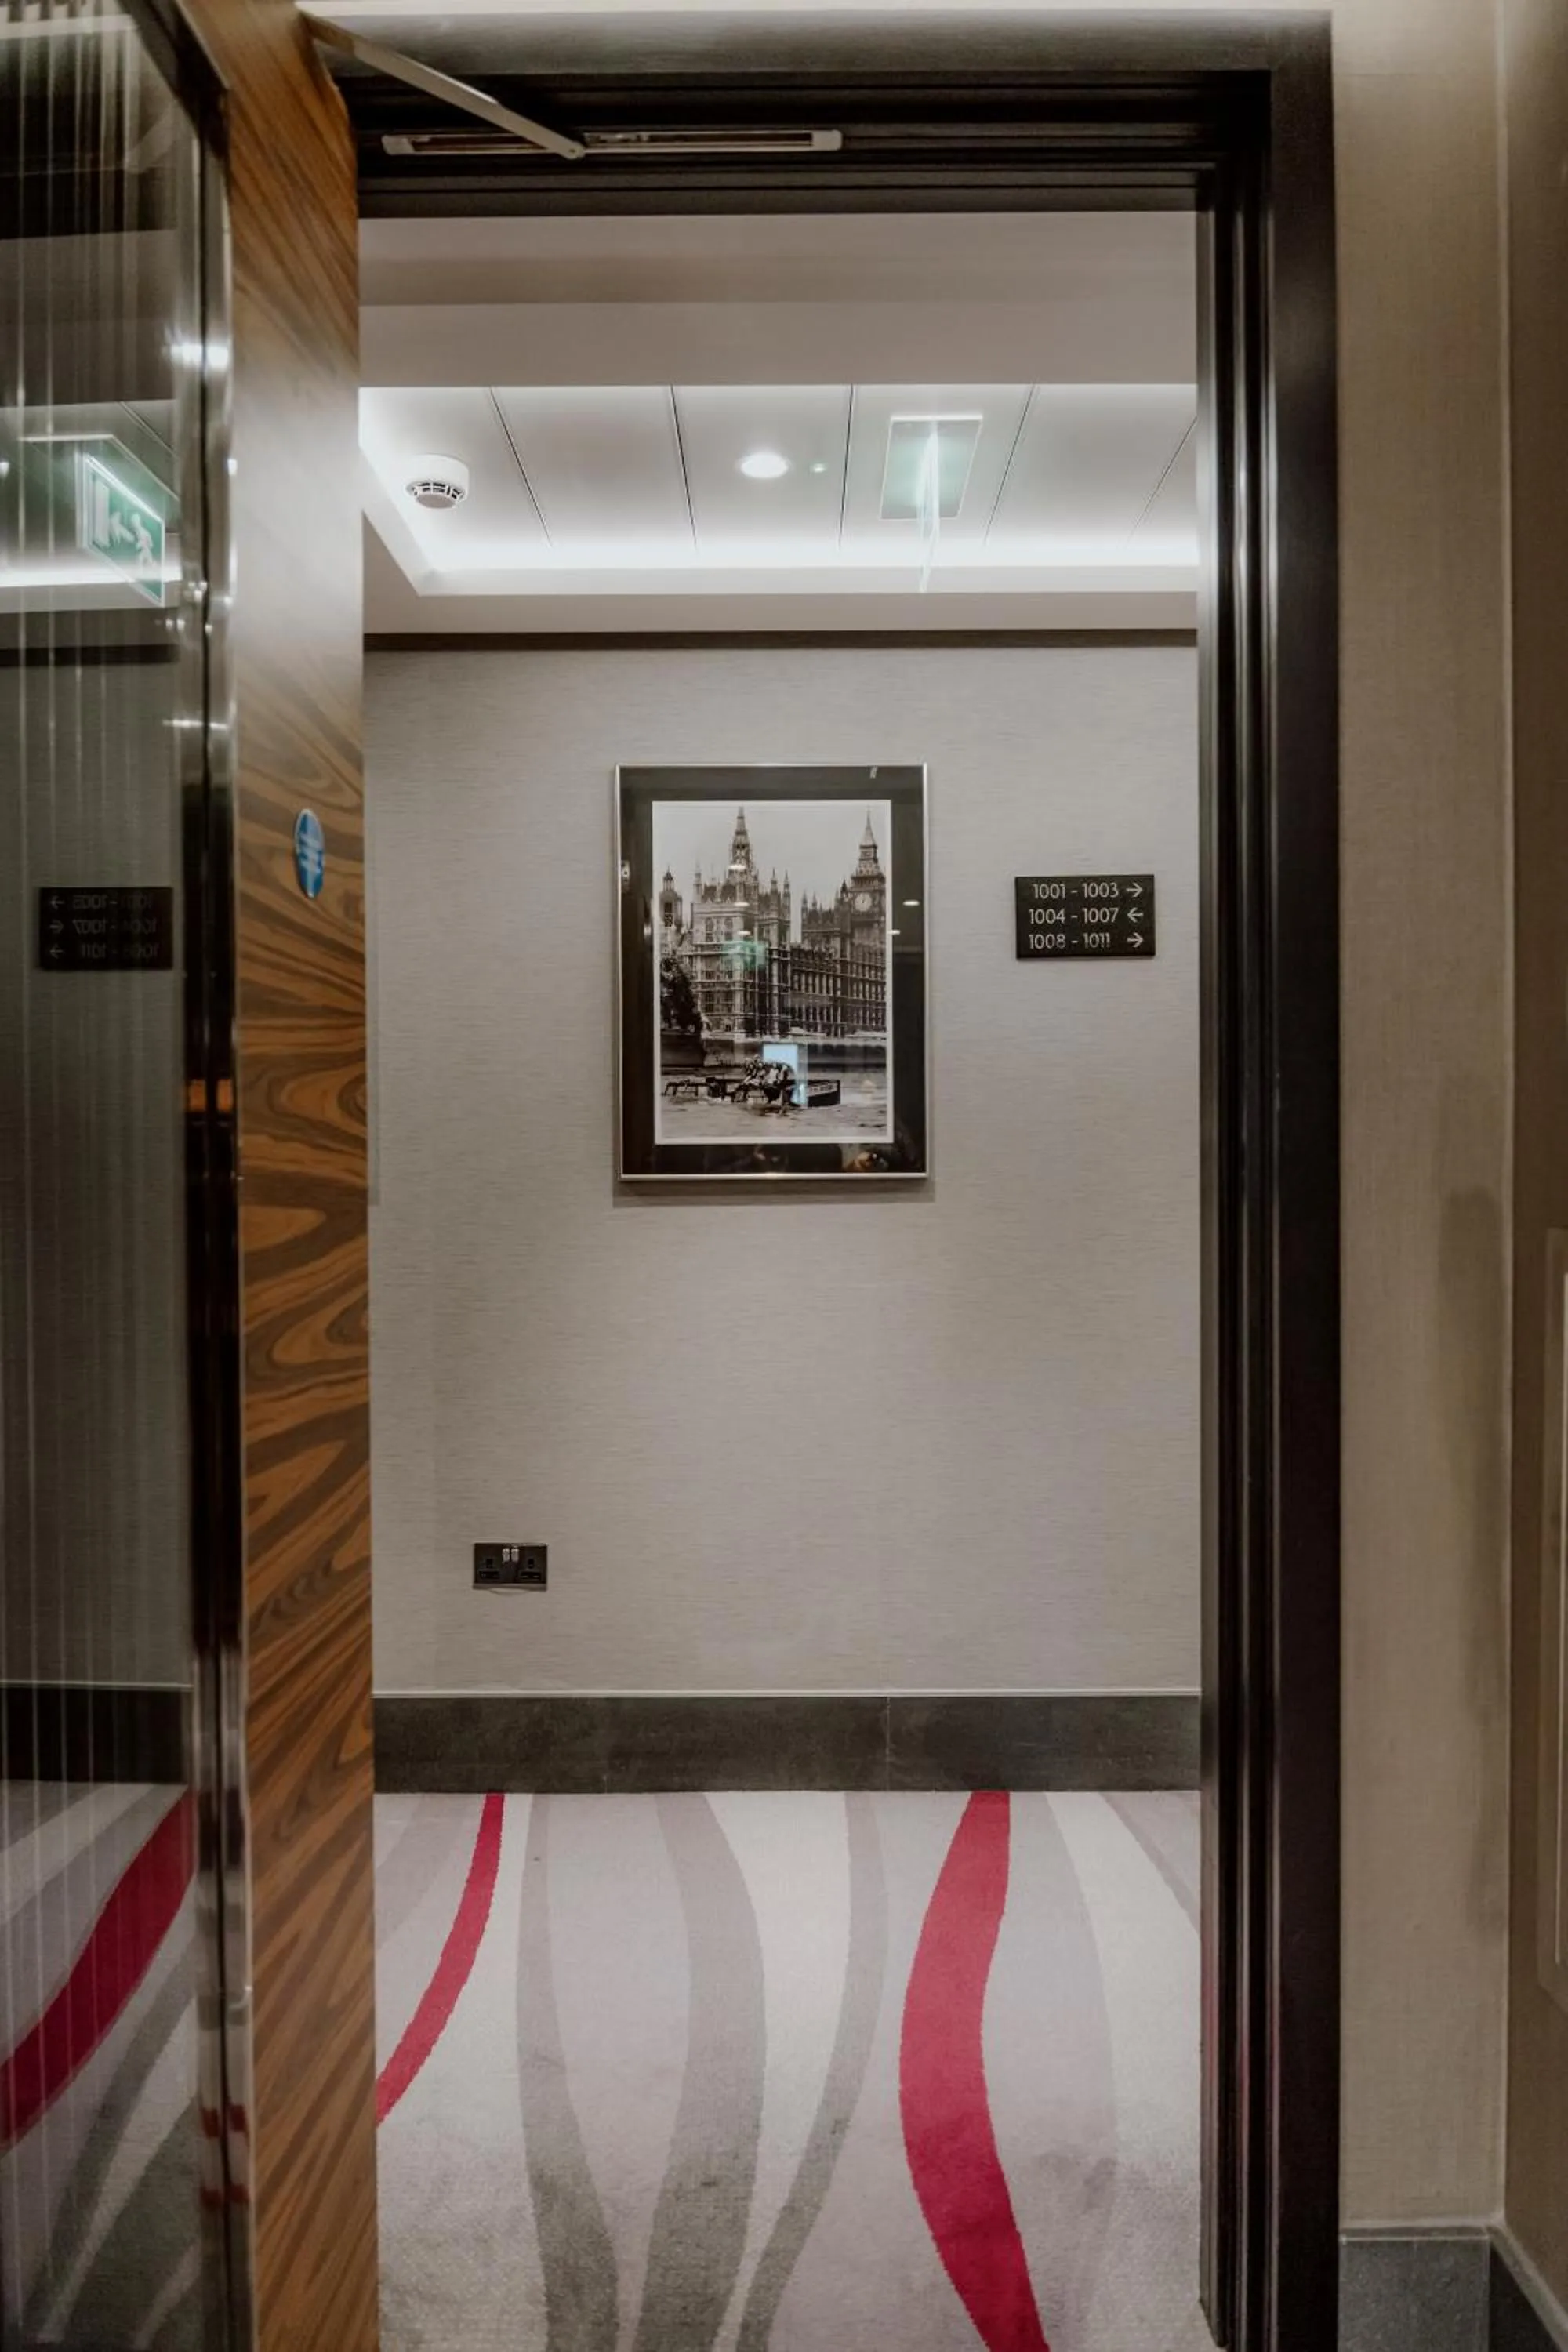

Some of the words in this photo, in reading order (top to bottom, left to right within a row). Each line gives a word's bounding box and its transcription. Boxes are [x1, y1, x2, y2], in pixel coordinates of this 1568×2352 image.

[1032, 883, 1065, 899] 1001
[1081, 881, 1120, 898] 1003
[1028, 908, 1066, 924] 1004
[1082, 907, 1120, 924] 1007
[1028, 933, 1065, 949] 1008
[1083, 932, 1110, 948] 1011
